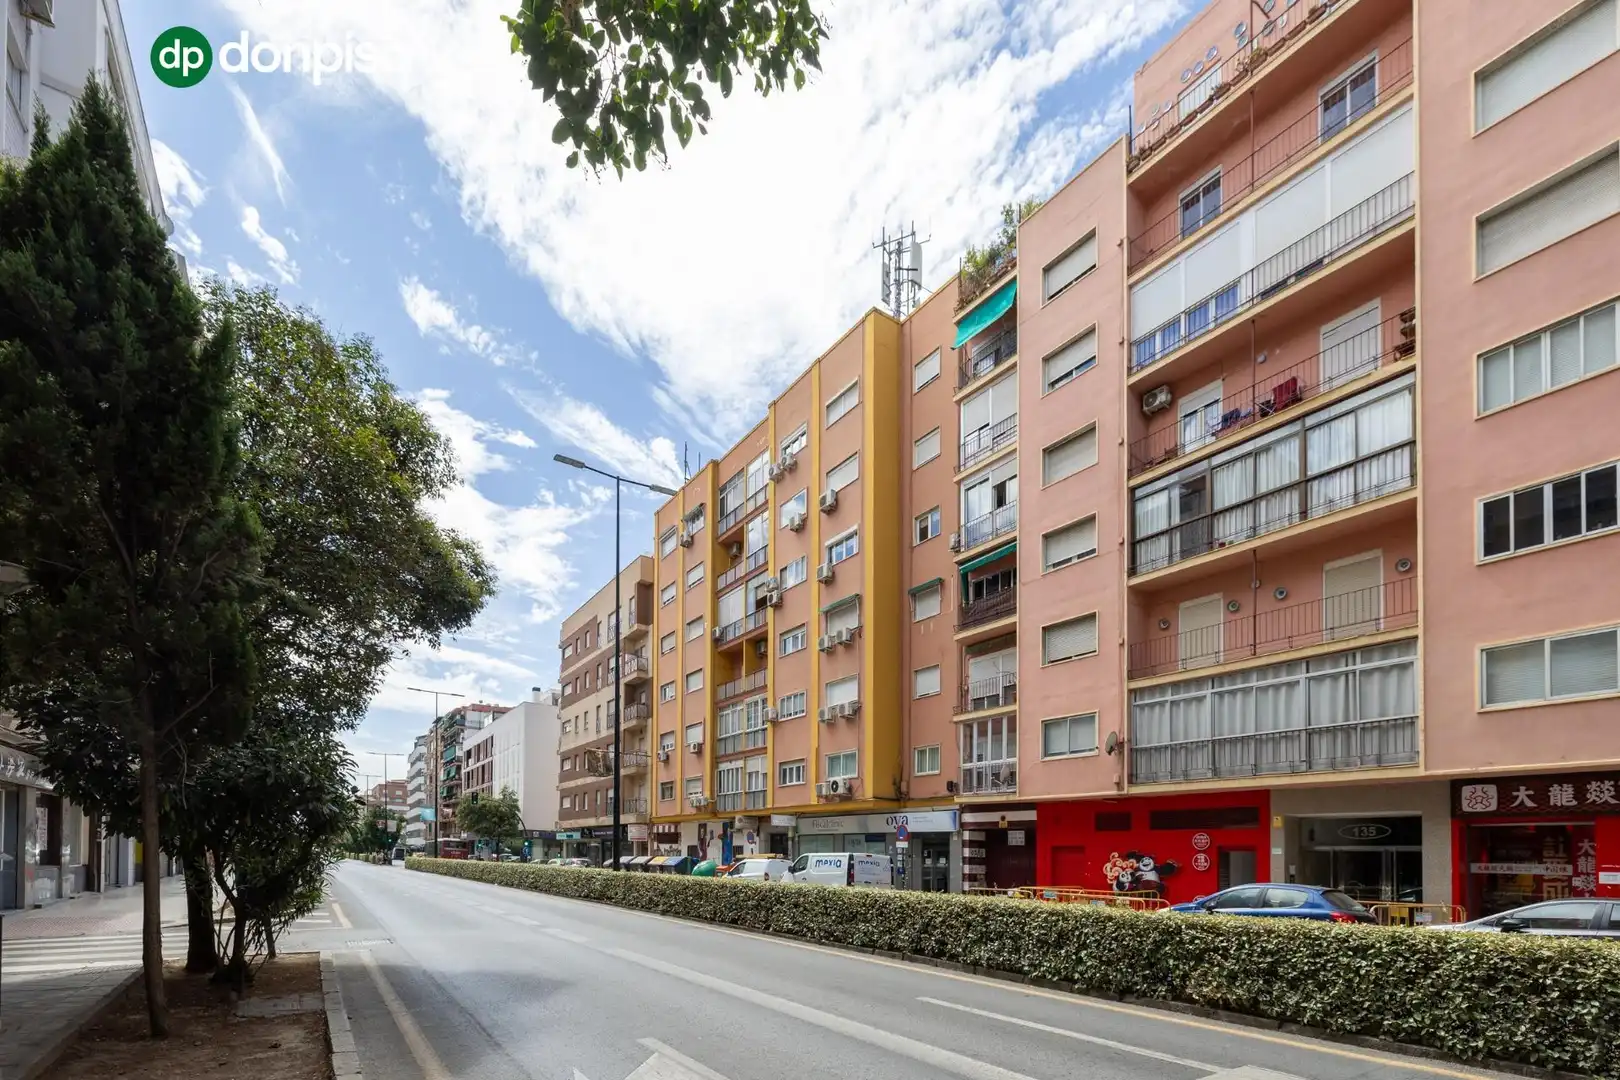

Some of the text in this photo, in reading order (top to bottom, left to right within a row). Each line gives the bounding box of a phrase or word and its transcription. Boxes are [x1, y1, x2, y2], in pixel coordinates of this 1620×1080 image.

[1352, 826, 1377, 837] 135
[1577, 839, 1597, 898] 大龍燚
